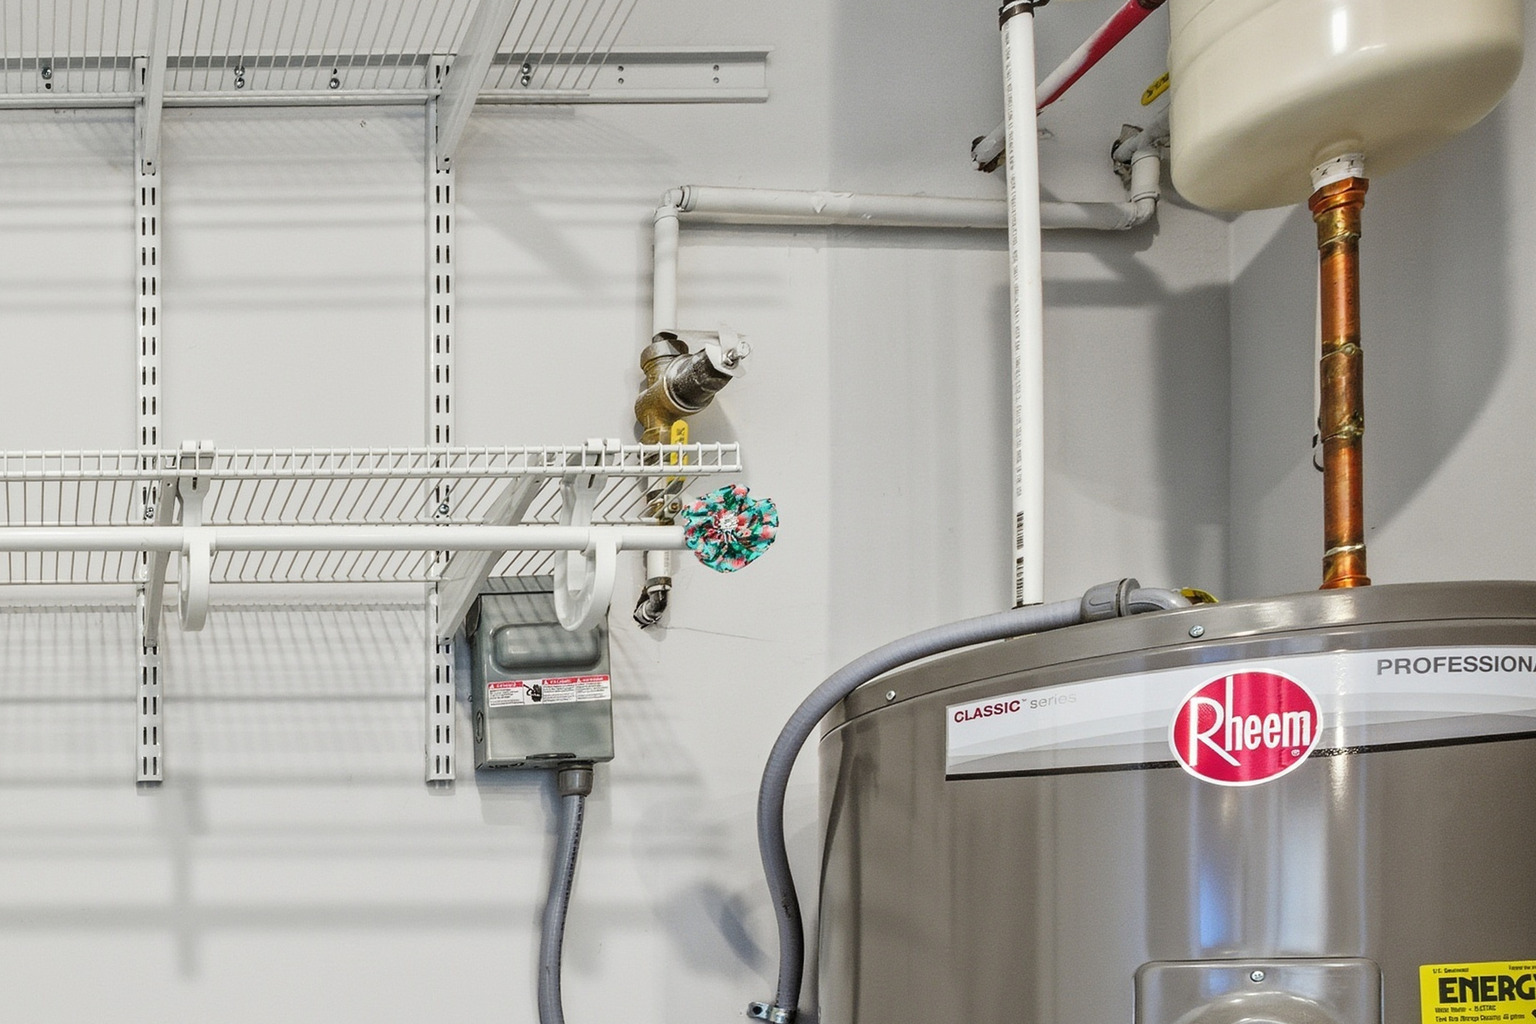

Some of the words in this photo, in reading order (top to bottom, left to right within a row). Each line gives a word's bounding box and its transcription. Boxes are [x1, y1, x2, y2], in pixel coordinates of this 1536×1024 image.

[1377, 655, 1536, 676] PROFESSION
[954, 700, 1020, 723] CLASSIC
[1030, 693, 1077, 709] series
[1189, 676, 1311, 767] Rheem
